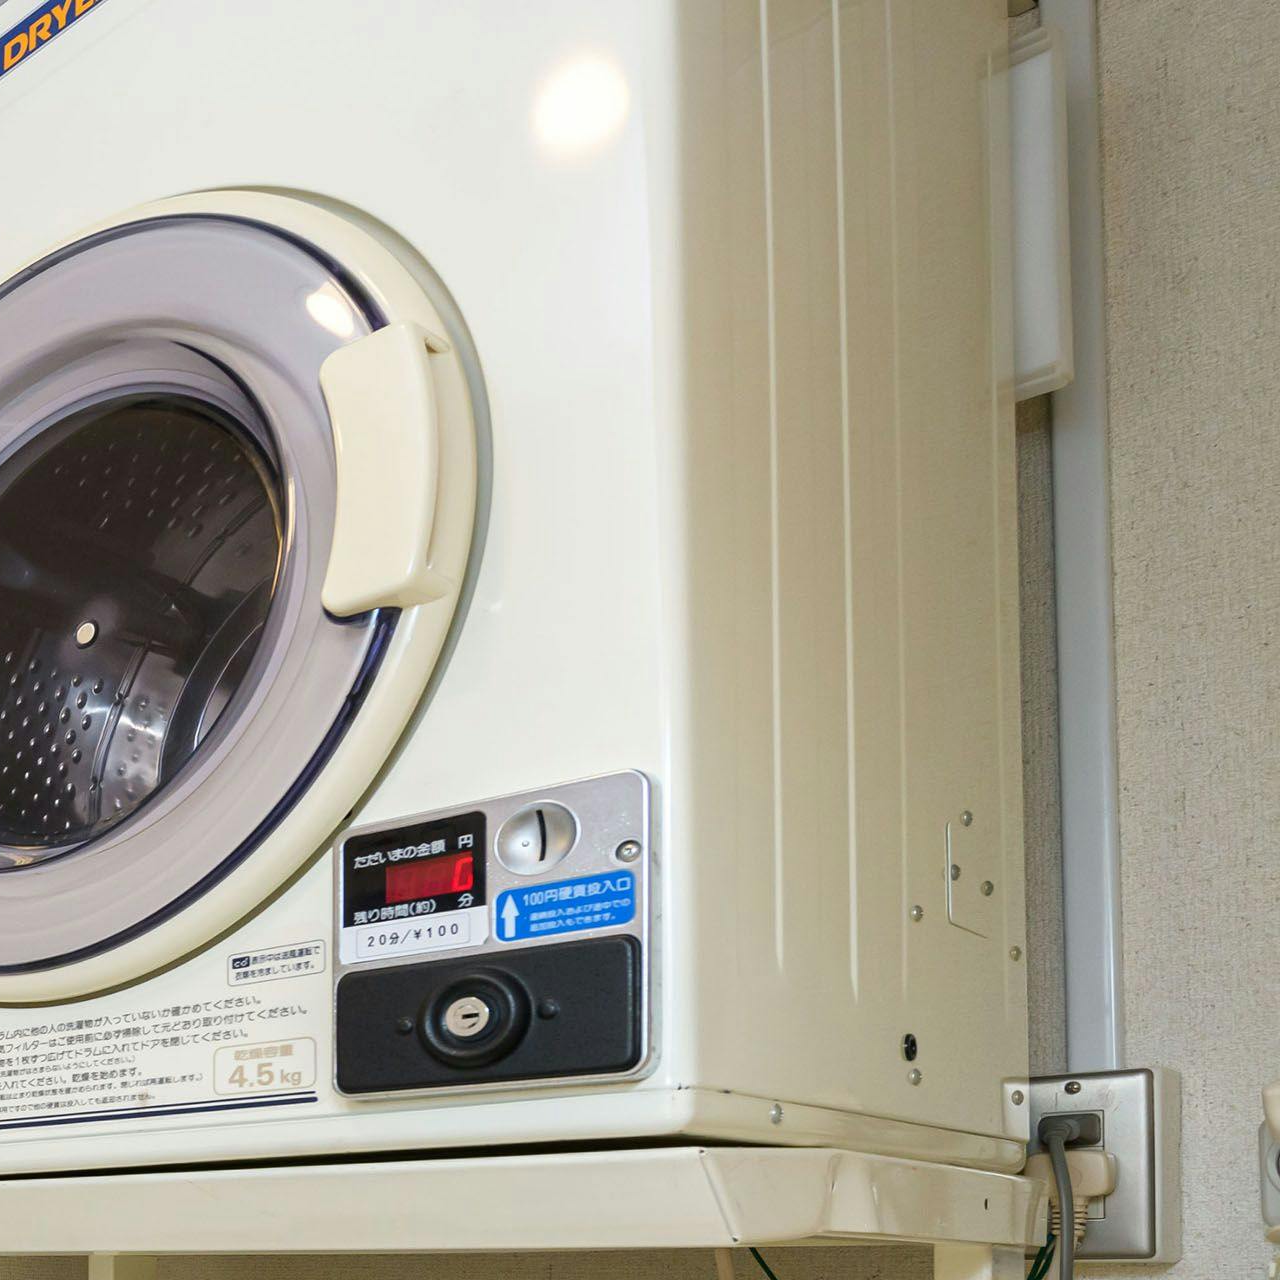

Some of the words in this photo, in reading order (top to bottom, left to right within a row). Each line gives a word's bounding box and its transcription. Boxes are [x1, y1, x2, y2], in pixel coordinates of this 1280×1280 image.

[353, 839, 445, 869] ただいまの金額
[458, 834, 473, 848] 円
[459, 893, 474, 907] 分
[523, 877, 631, 906] 100円硬貨投入口
[229, 1062, 274, 1088] 4.5
